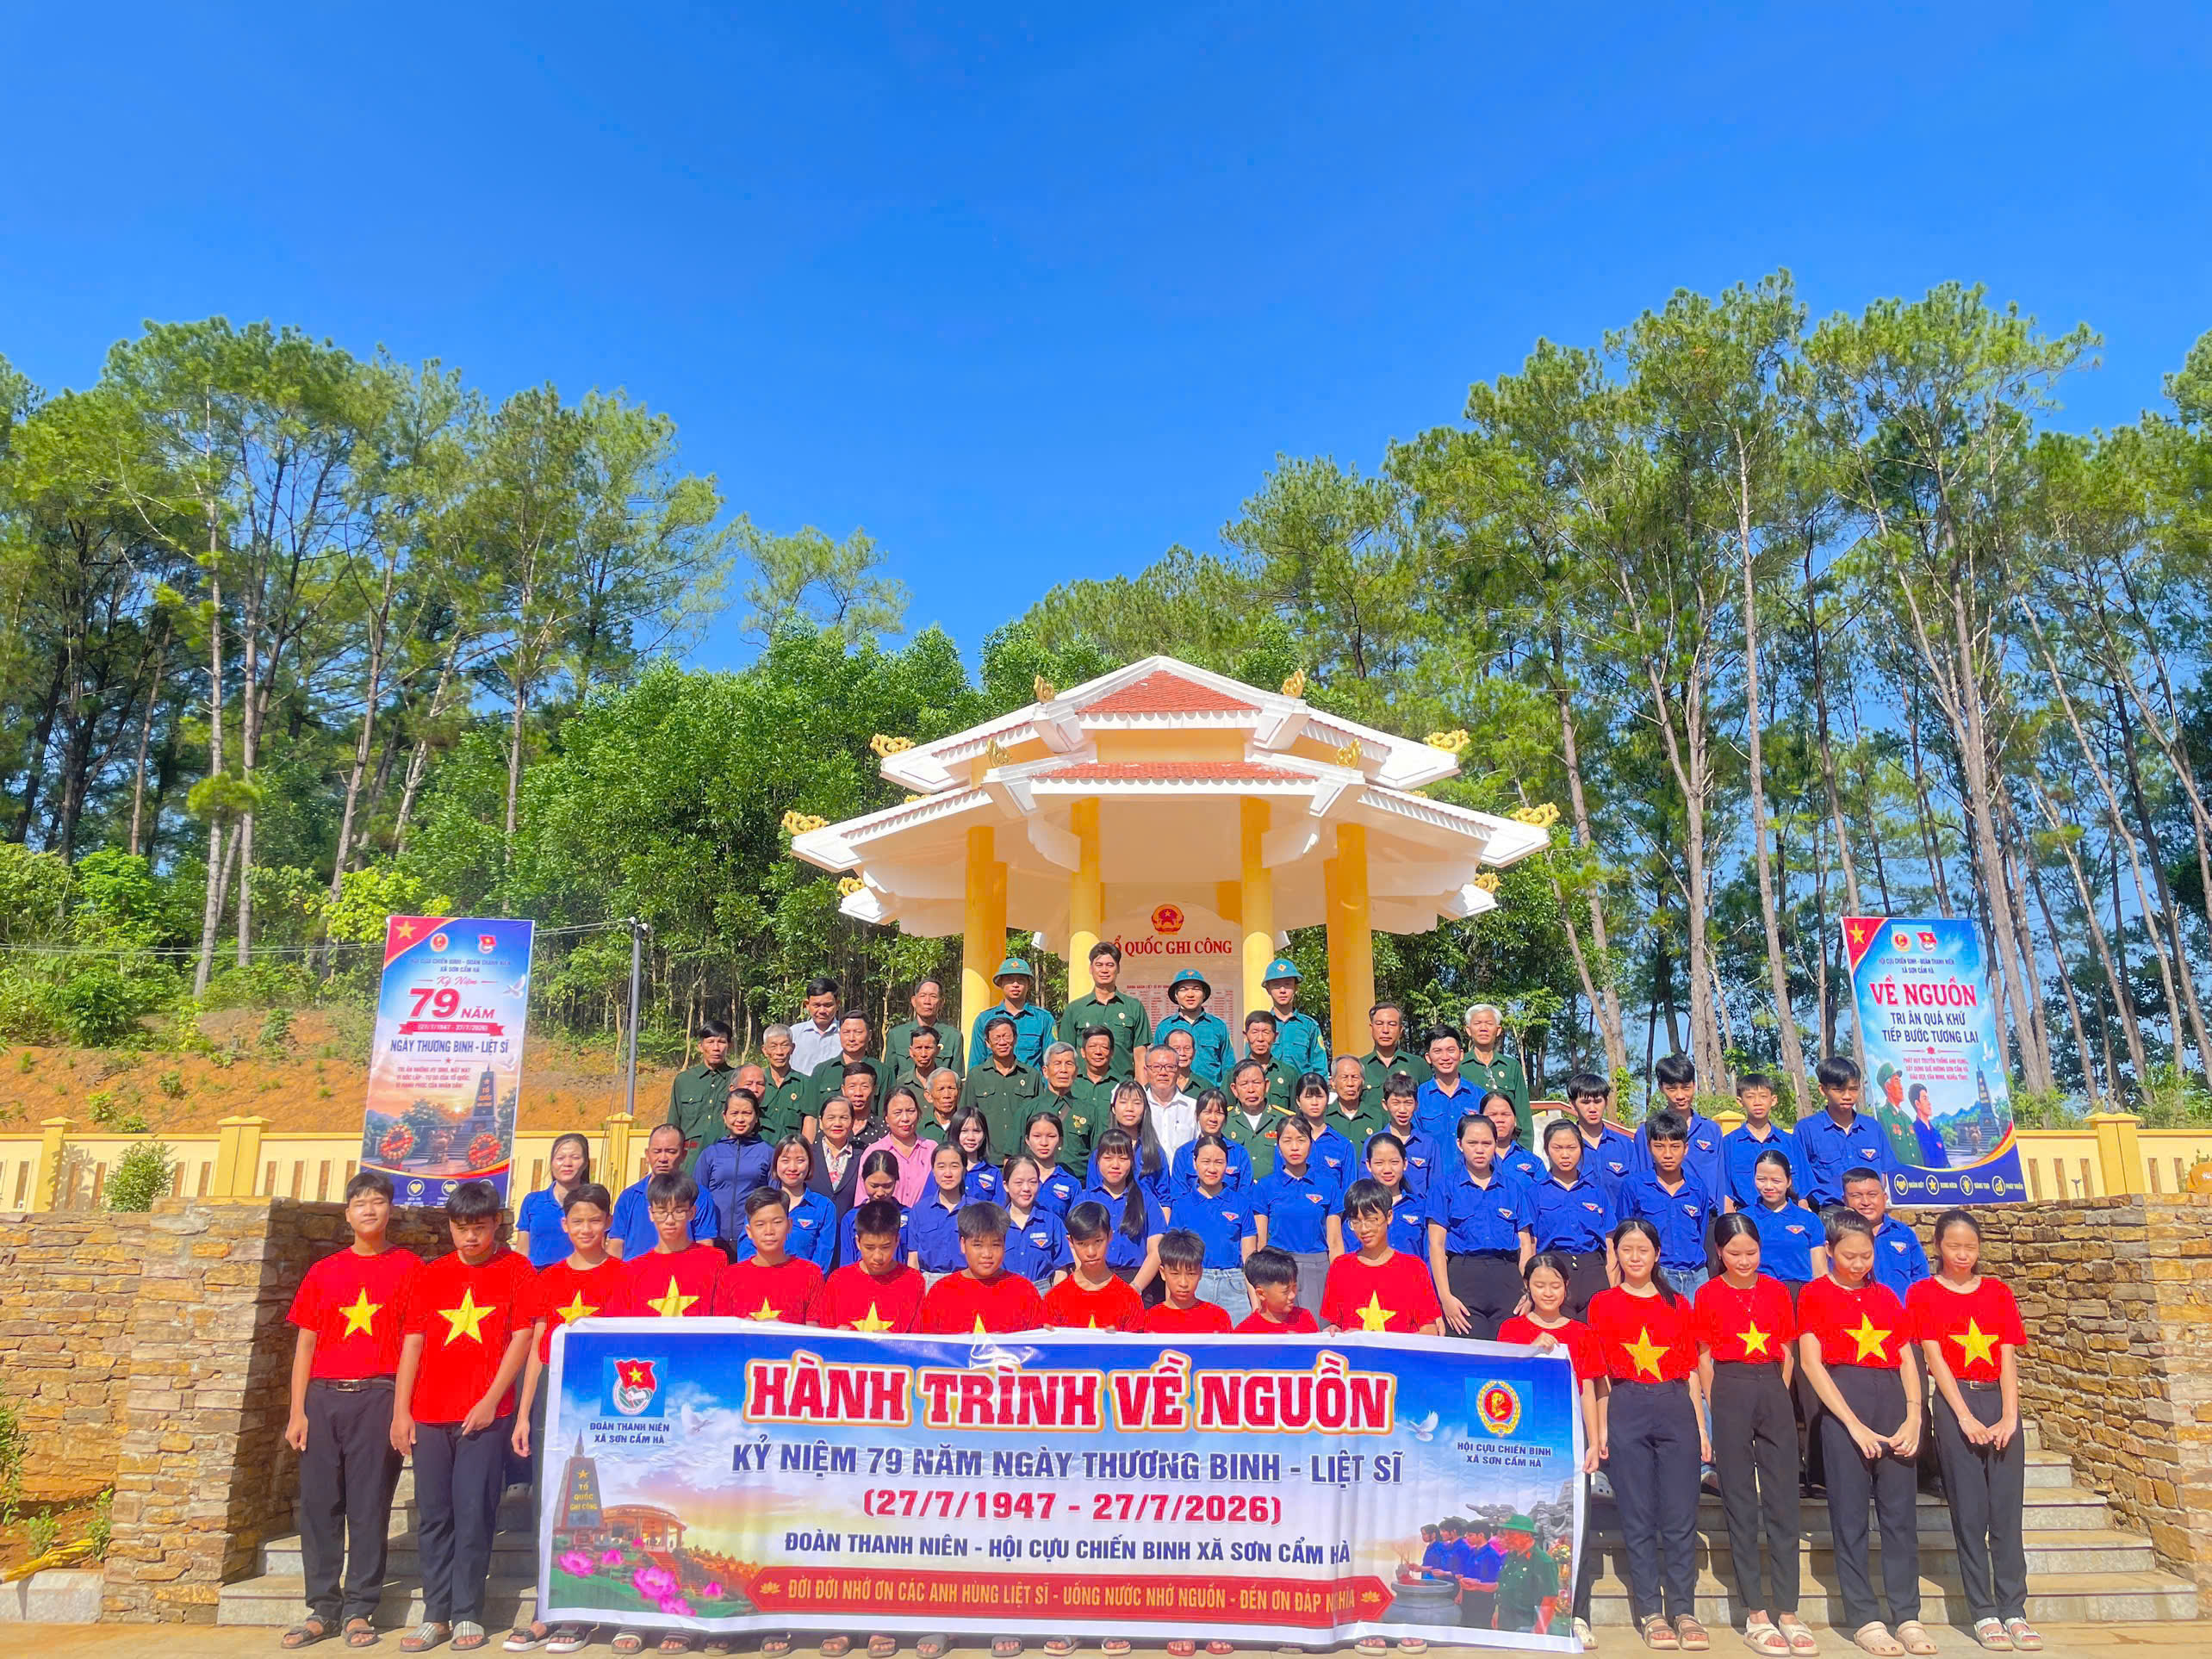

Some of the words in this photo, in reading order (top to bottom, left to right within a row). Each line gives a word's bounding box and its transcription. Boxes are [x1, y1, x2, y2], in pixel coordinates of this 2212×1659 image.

[1125, 935, 1163, 957] QUỐC
[1165, 941, 1191, 954] GHI
[1195, 937, 1232, 954] CÔNG
[1869, 974, 1898, 1005] VỀ
[1903, 975, 1978, 1006] NGUỒN
[409, 988, 461, 1019] 79
[461, 1006, 495, 1019] NĂM
[1890, 1012, 1906, 1025] TRI
[1909, 1010, 1922, 1025] ÂN
[1923, 1010, 1944, 1027] QUÁ
[1946, 1010, 1966, 1025] KHỨ
[1881, 1026, 1902, 1042] TIẾP
[1904, 1028, 1929, 1042] BƯỚC
[1930, 1029, 1962, 1043] TƯƠNG
[1964, 1030, 1979, 1043] LAI
[390, 1037, 414, 1052] NGÀY
[417, 1039, 451, 1052] THƯƠNG
[454, 1041, 474, 1053] BINH
[481, 1039, 498, 1055] LIỆT
[500, 1039, 510, 1053] SĨ
[749, 1357, 907, 1421] HÀNH
[922, 1364, 1097, 1426] TRÌNH
[1115, 1357, 1184, 1426] VỀ
[1200, 1357, 1389, 1429] NGUỒN
[589, 1420, 614, 1431] ĐOÀN
[617, 1422, 646, 1431] THANH
[649, 1422, 670, 1432] NIÊN
[609, 1434, 627, 1443] SƠN
[653, 1434, 664, 1444] HÀ
[1457, 1441, 1473, 1452] HỘI
[1476, 1443, 1494, 1454] CỰU
[1498, 1444, 1525, 1454] CHIẾN
[1529, 1447, 1551, 1456] BINH
[732, 1433, 772, 1471] KỶ
[780, 1439, 857, 1478] NIỆM
[867, 1446, 904, 1475] 79
[913, 1443, 982, 1476] NĂM
[992, 1445, 1073, 1477] NGÀY
[1082, 1450, 1200, 1481] THƯƠNG
[1209, 1452, 1281, 1481] BINH
[1311, 1450, 1364, 1488] LIỆT
[1373, 1451, 1404, 1483] SĨ
[1466, 1454, 1479, 1463] XÃ
[1482, 1456, 1501, 1465] SƠN
[1529, 1457, 1542, 1467] HÀ
[864, 1488, 1057, 1519] (27/7/1947
[1092, 1493, 1282, 1525] 27/7/2026)
[785, 1528, 841, 1551] ĐOÀN
[848, 1533, 913, 1554] THANH
[920, 1534, 968, 1556] NIÊN
[989, 1535, 1022, 1562] HỘI
[1028, 1538, 1069, 1563] CỰU
[1076, 1534, 1136, 1559] CHIẾN
[1143, 1541, 1190, 1560] BINH
[1230, 1541, 1271, 1562] SƠN
[1278, 1537, 1323, 1564] CẨM
[1330, 1540, 1350, 1564] HÀ
[788, 1575, 811, 1600] ĐỜI
[815, 1575, 838, 1600] ĐỜI
[842, 1576, 872, 1600] NHỚ
[874, 1579, 894, 1600] ƠN
[898, 1577, 925, 1601] CÁC
[929, 1582, 957, 1603] ANH
[962, 1580, 999, 1604] HÙNG
[1003, 1581, 1031, 1608] LIỆT
[1035, 1581, 1049, 1605] SĨ
[1063, 1580, 1101, 1606] UỐNG
[1104, 1582, 1141, 1606] NƯỚC
[1146, 1582, 1175, 1607] NHỚ
[1271, 1588, 1290, 1611] ƠN
[1295, 1588, 1322, 1613] ĐÁP
